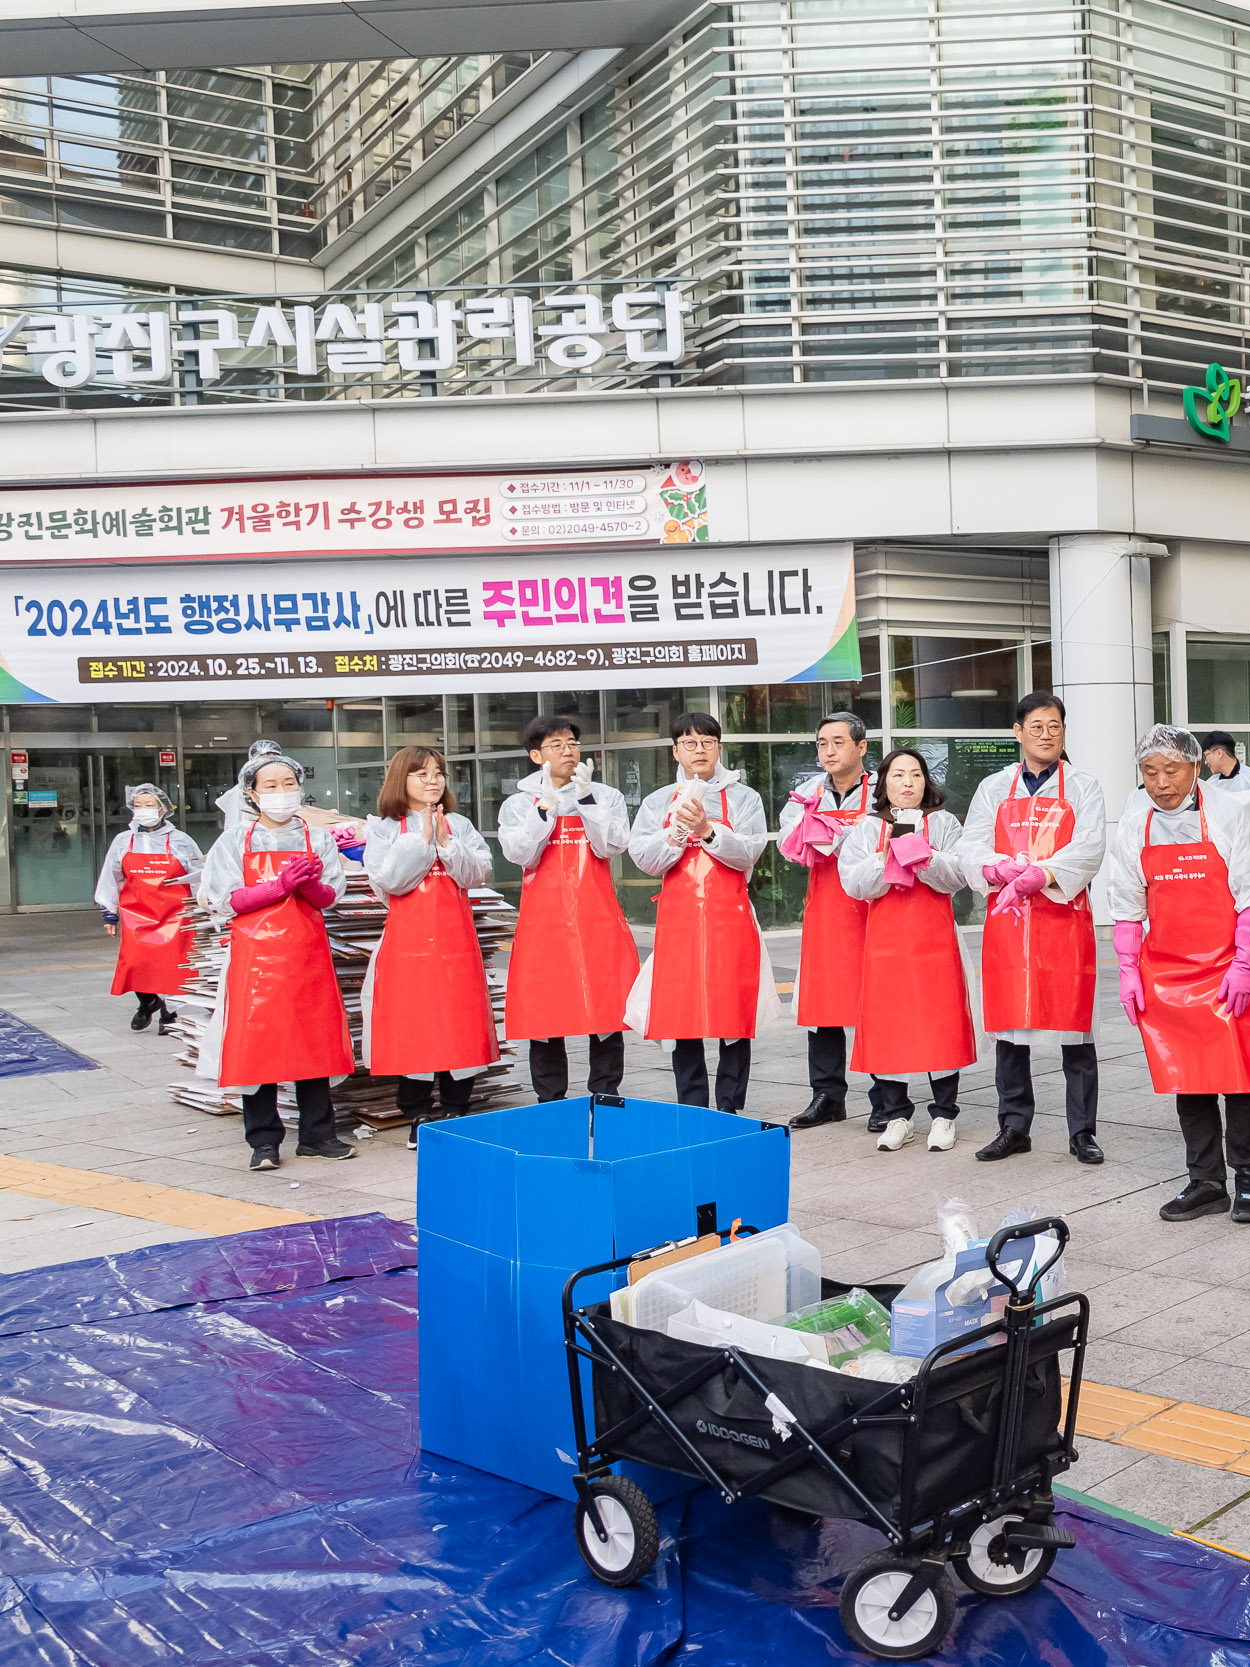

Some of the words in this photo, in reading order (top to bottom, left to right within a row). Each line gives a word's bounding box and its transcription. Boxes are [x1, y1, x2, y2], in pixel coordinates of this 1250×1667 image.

[26, 289, 692, 388] 광진구시설관리공단
[520, 481, 560, 494] 접수기간
[569, 481, 591, 492] 11/1
[604, 479, 634, 491] 11/30
[220, 500, 331, 533] 겨울학기
[338, 499, 425, 530] 수강생
[433, 497, 491, 527] 모집
[521, 503, 561, 515] 접수방법
[569, 502, 591, 514] 방문
[593, 501, 603, 512] 및
[605, 500, 636, 512] 인터넷
[521, 524, 540, 536] 문의
[413, 588, 472, 627] 따른
[481, 574, 660, 628] 주민의견을
[671, 568, 823, 620] 받습니다.
[89, 661, 146, 679] 접수기간
[335, 654, 378, 673] 접수처
[611, 645, 684, 665] 광진구의회
[688, 642, 747, 663] 홈페이지
